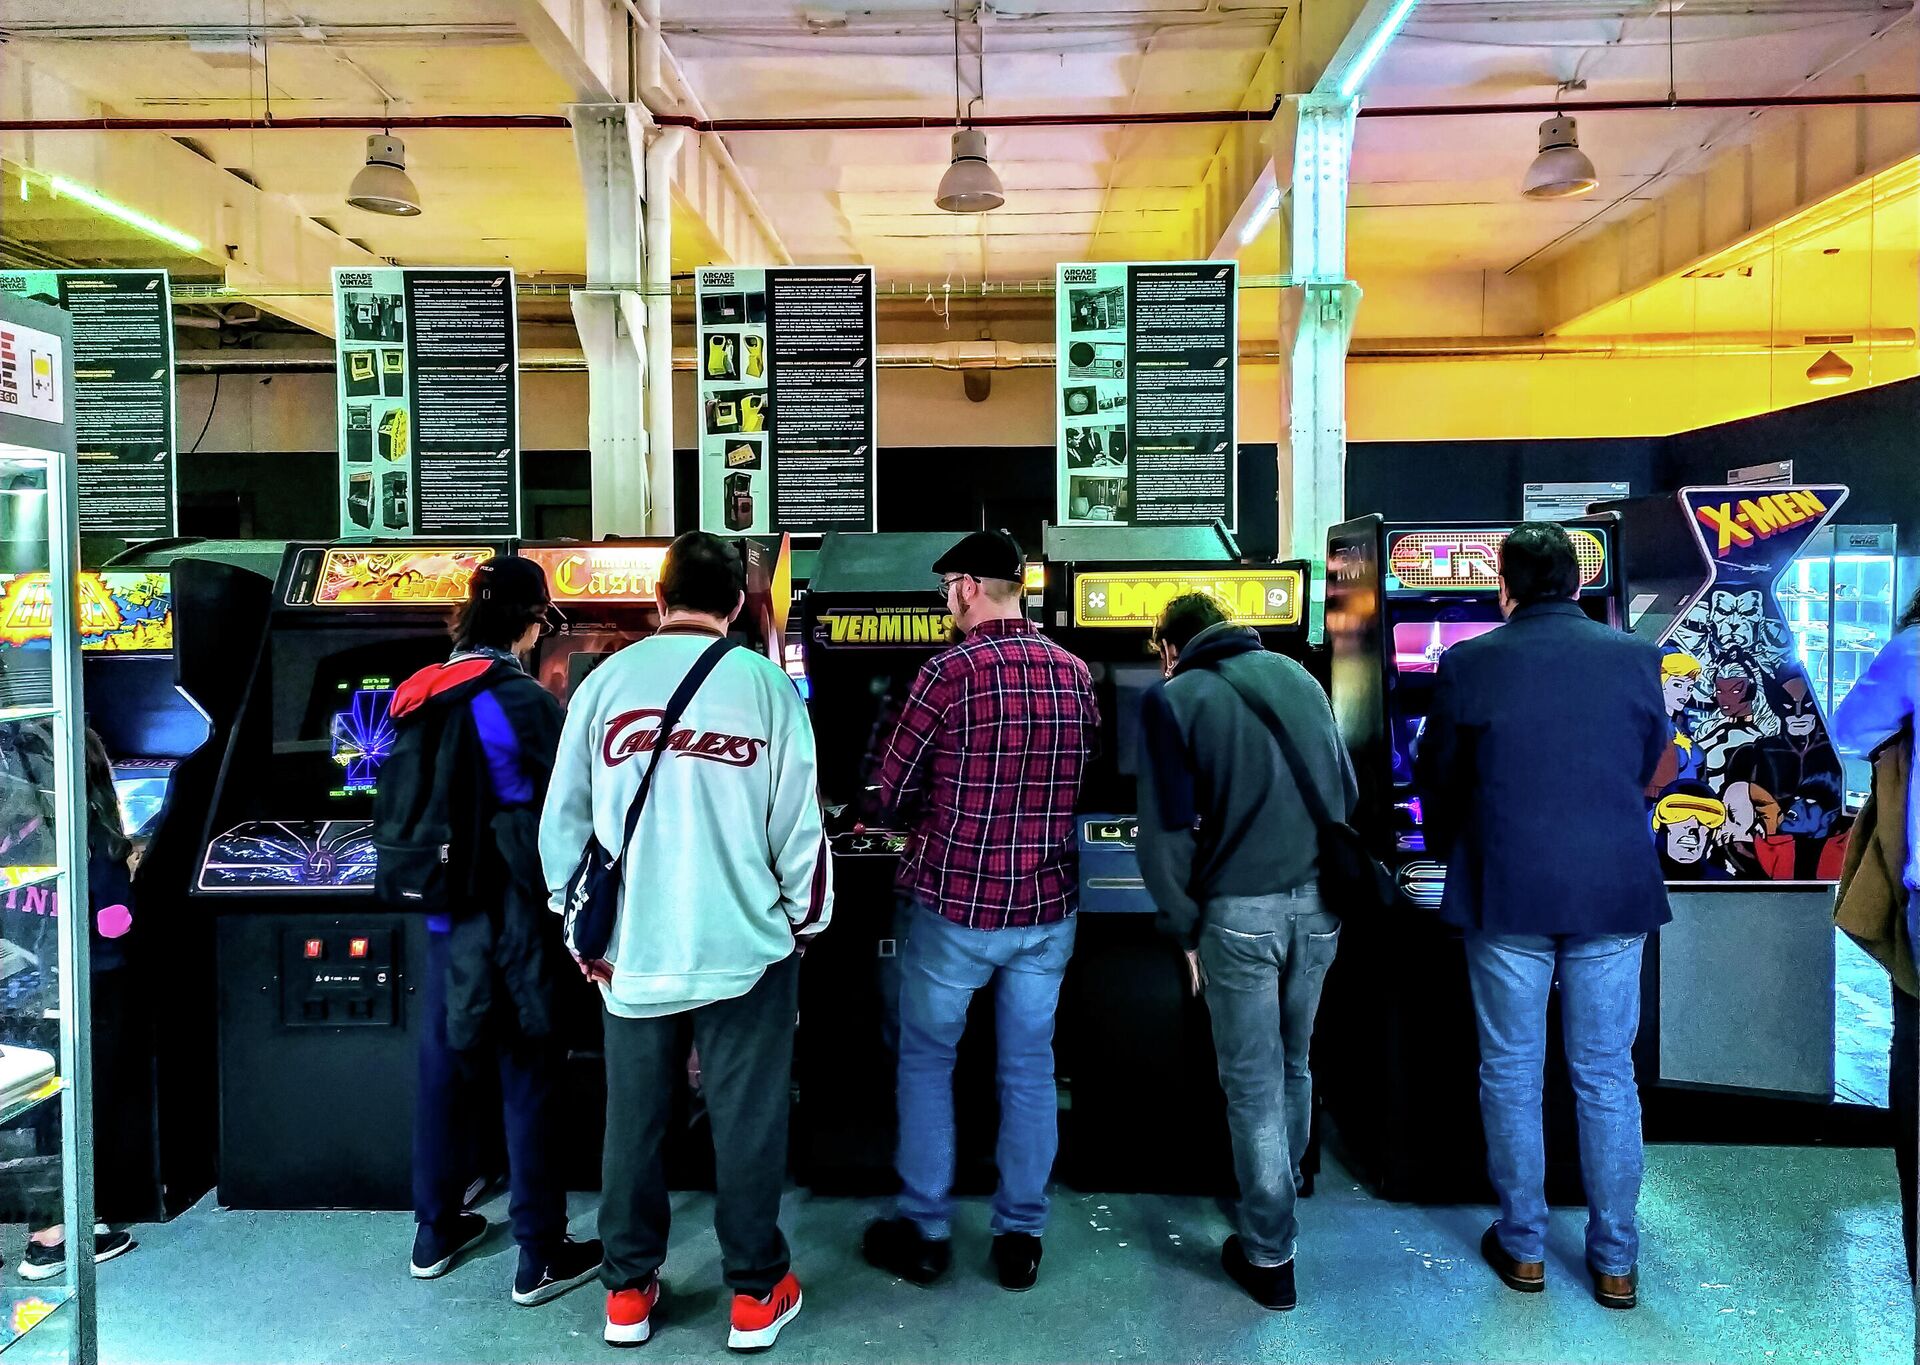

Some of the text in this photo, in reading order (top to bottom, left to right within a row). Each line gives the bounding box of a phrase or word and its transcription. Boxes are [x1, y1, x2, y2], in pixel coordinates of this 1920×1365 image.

[0, 390, 17, 403] EGO
[1696, 489, 1828, 557] X-MEN
[1422, 542, 1500, 577] TR
[390, 571, 474, 598] TEMPES
[816, 615, 955, 642] VERMINES
